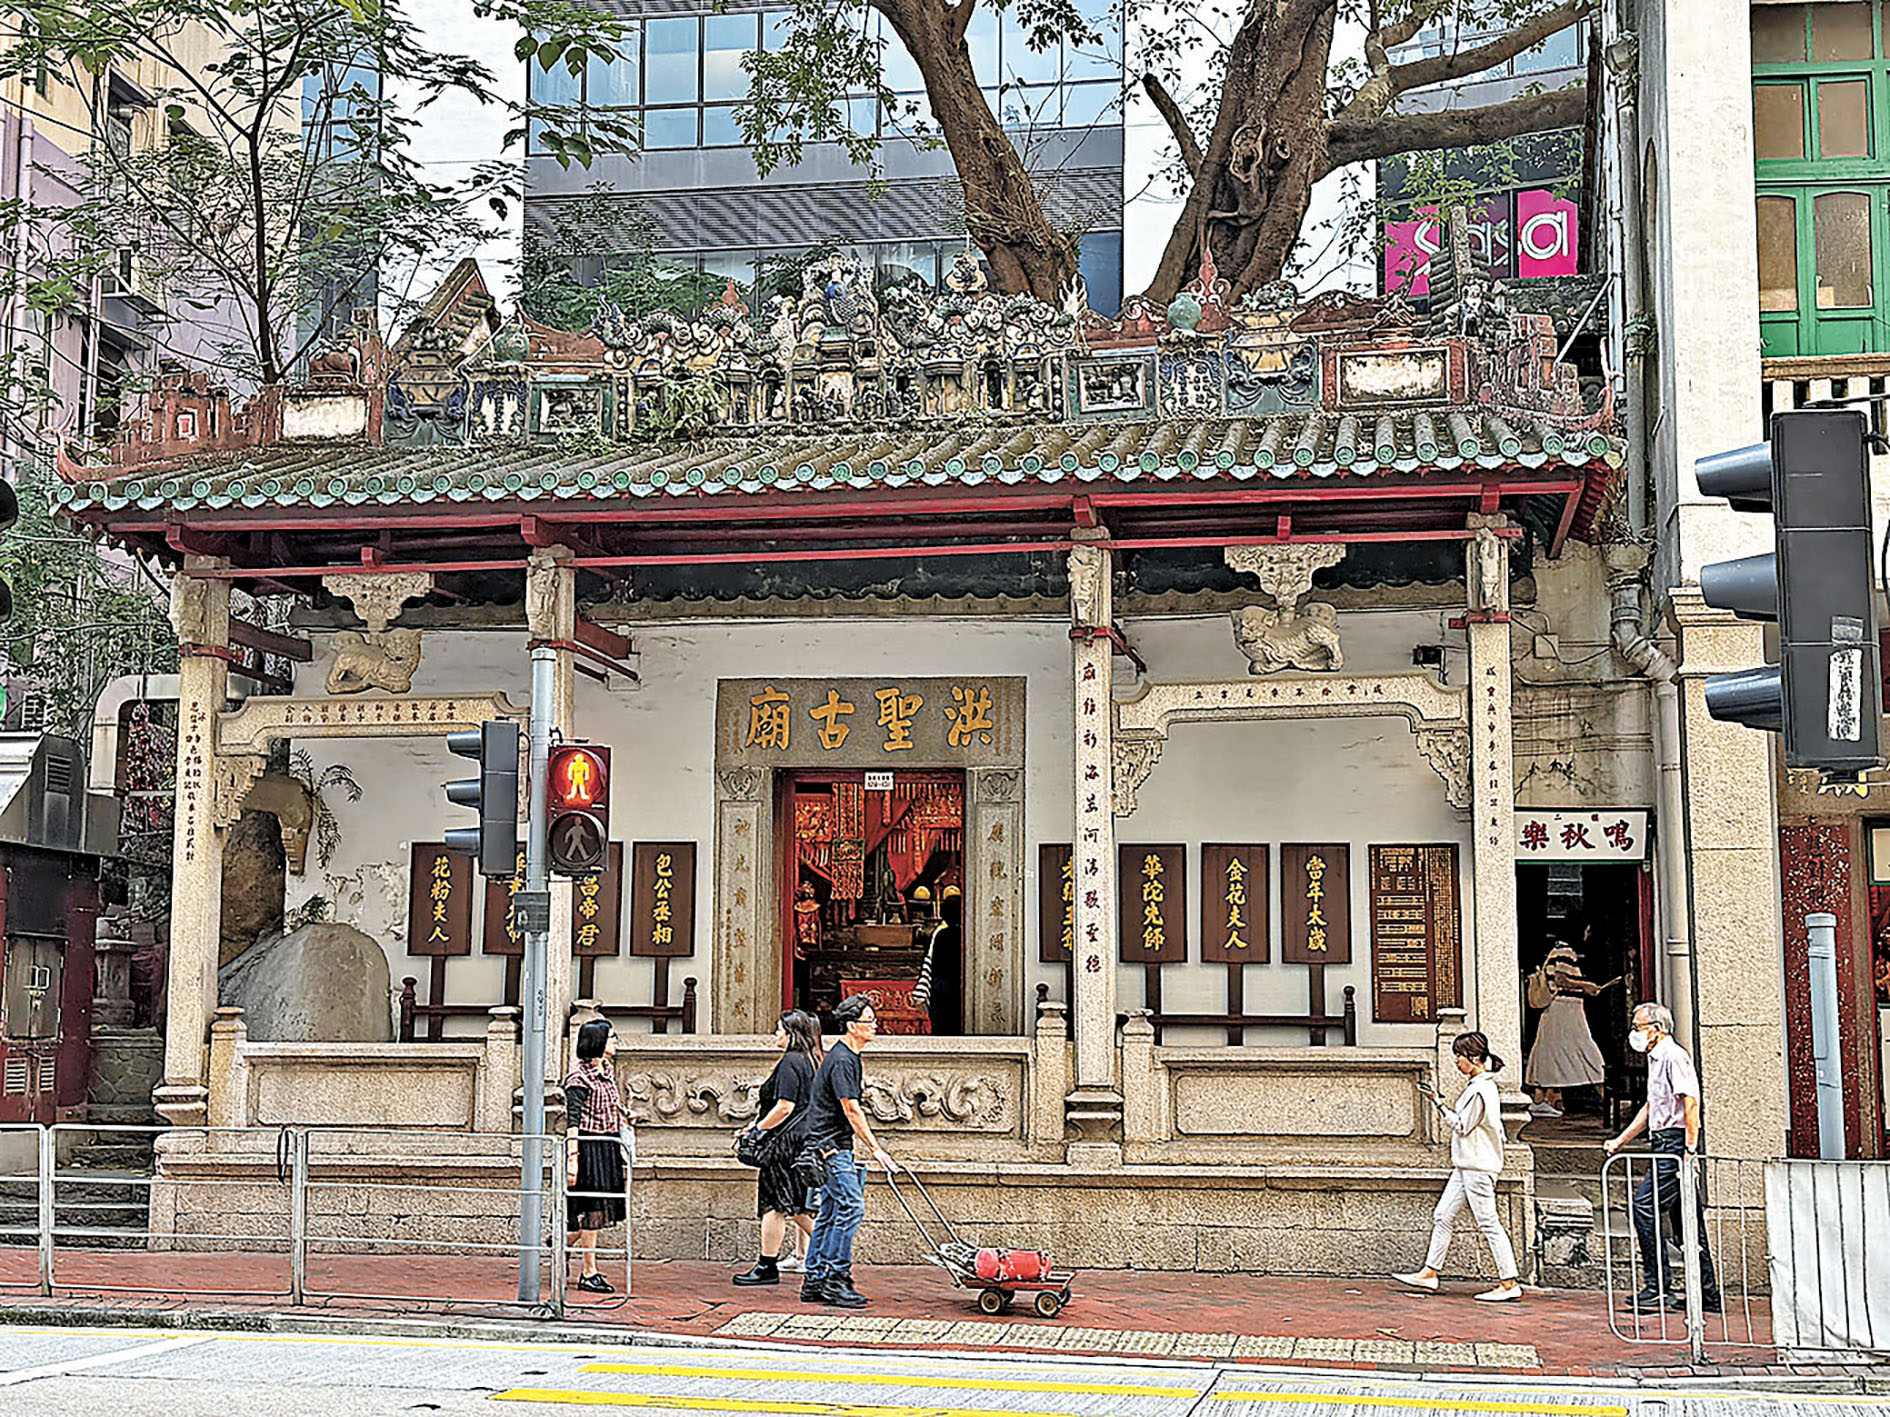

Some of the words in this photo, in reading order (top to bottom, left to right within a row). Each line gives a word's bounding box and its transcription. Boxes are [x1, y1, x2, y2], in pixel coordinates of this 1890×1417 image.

[744, 685, 993, 752] 洪聖古廟
[427, 855, 453, 943] 花粉夫人
[576, 875, 600, 946] 昌帝君
[652, 853, 674, 945] 包公丞相
[1224, 857, 1249, 949] 金花夫人
[1305, 855, 1328, 952] 當年太歲
